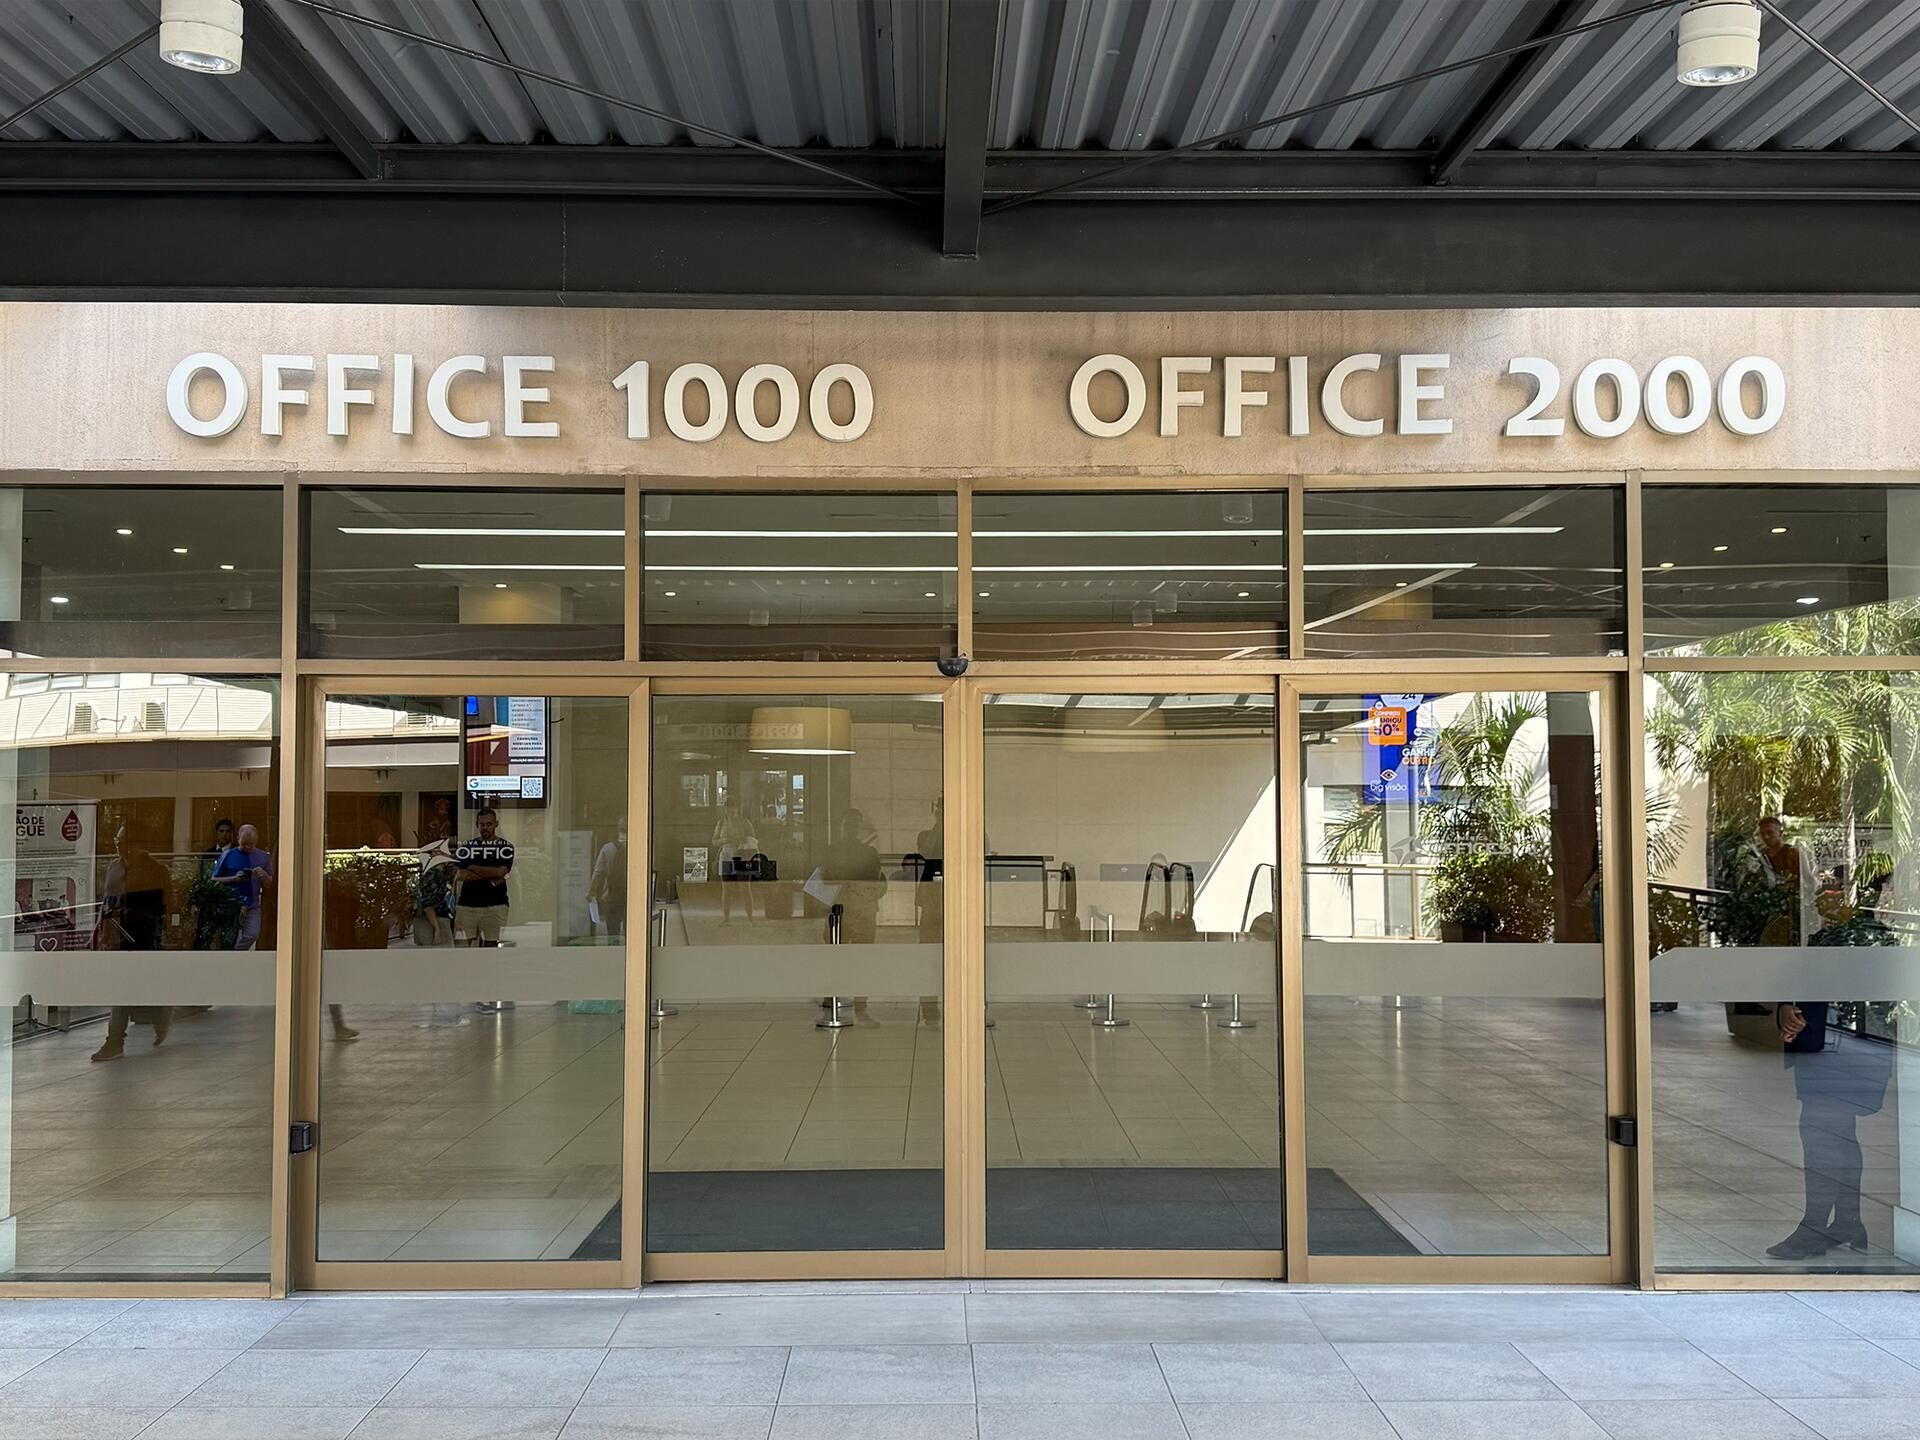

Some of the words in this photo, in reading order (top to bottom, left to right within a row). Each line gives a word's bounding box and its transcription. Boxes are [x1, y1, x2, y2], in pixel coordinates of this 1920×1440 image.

[166, 352, 560, 439] OFFICE
[612, 360, 875, 442] 1000
[1069, 353, 1453, 437] OFFICE
[1505, 355, 1787, 437] 2000
